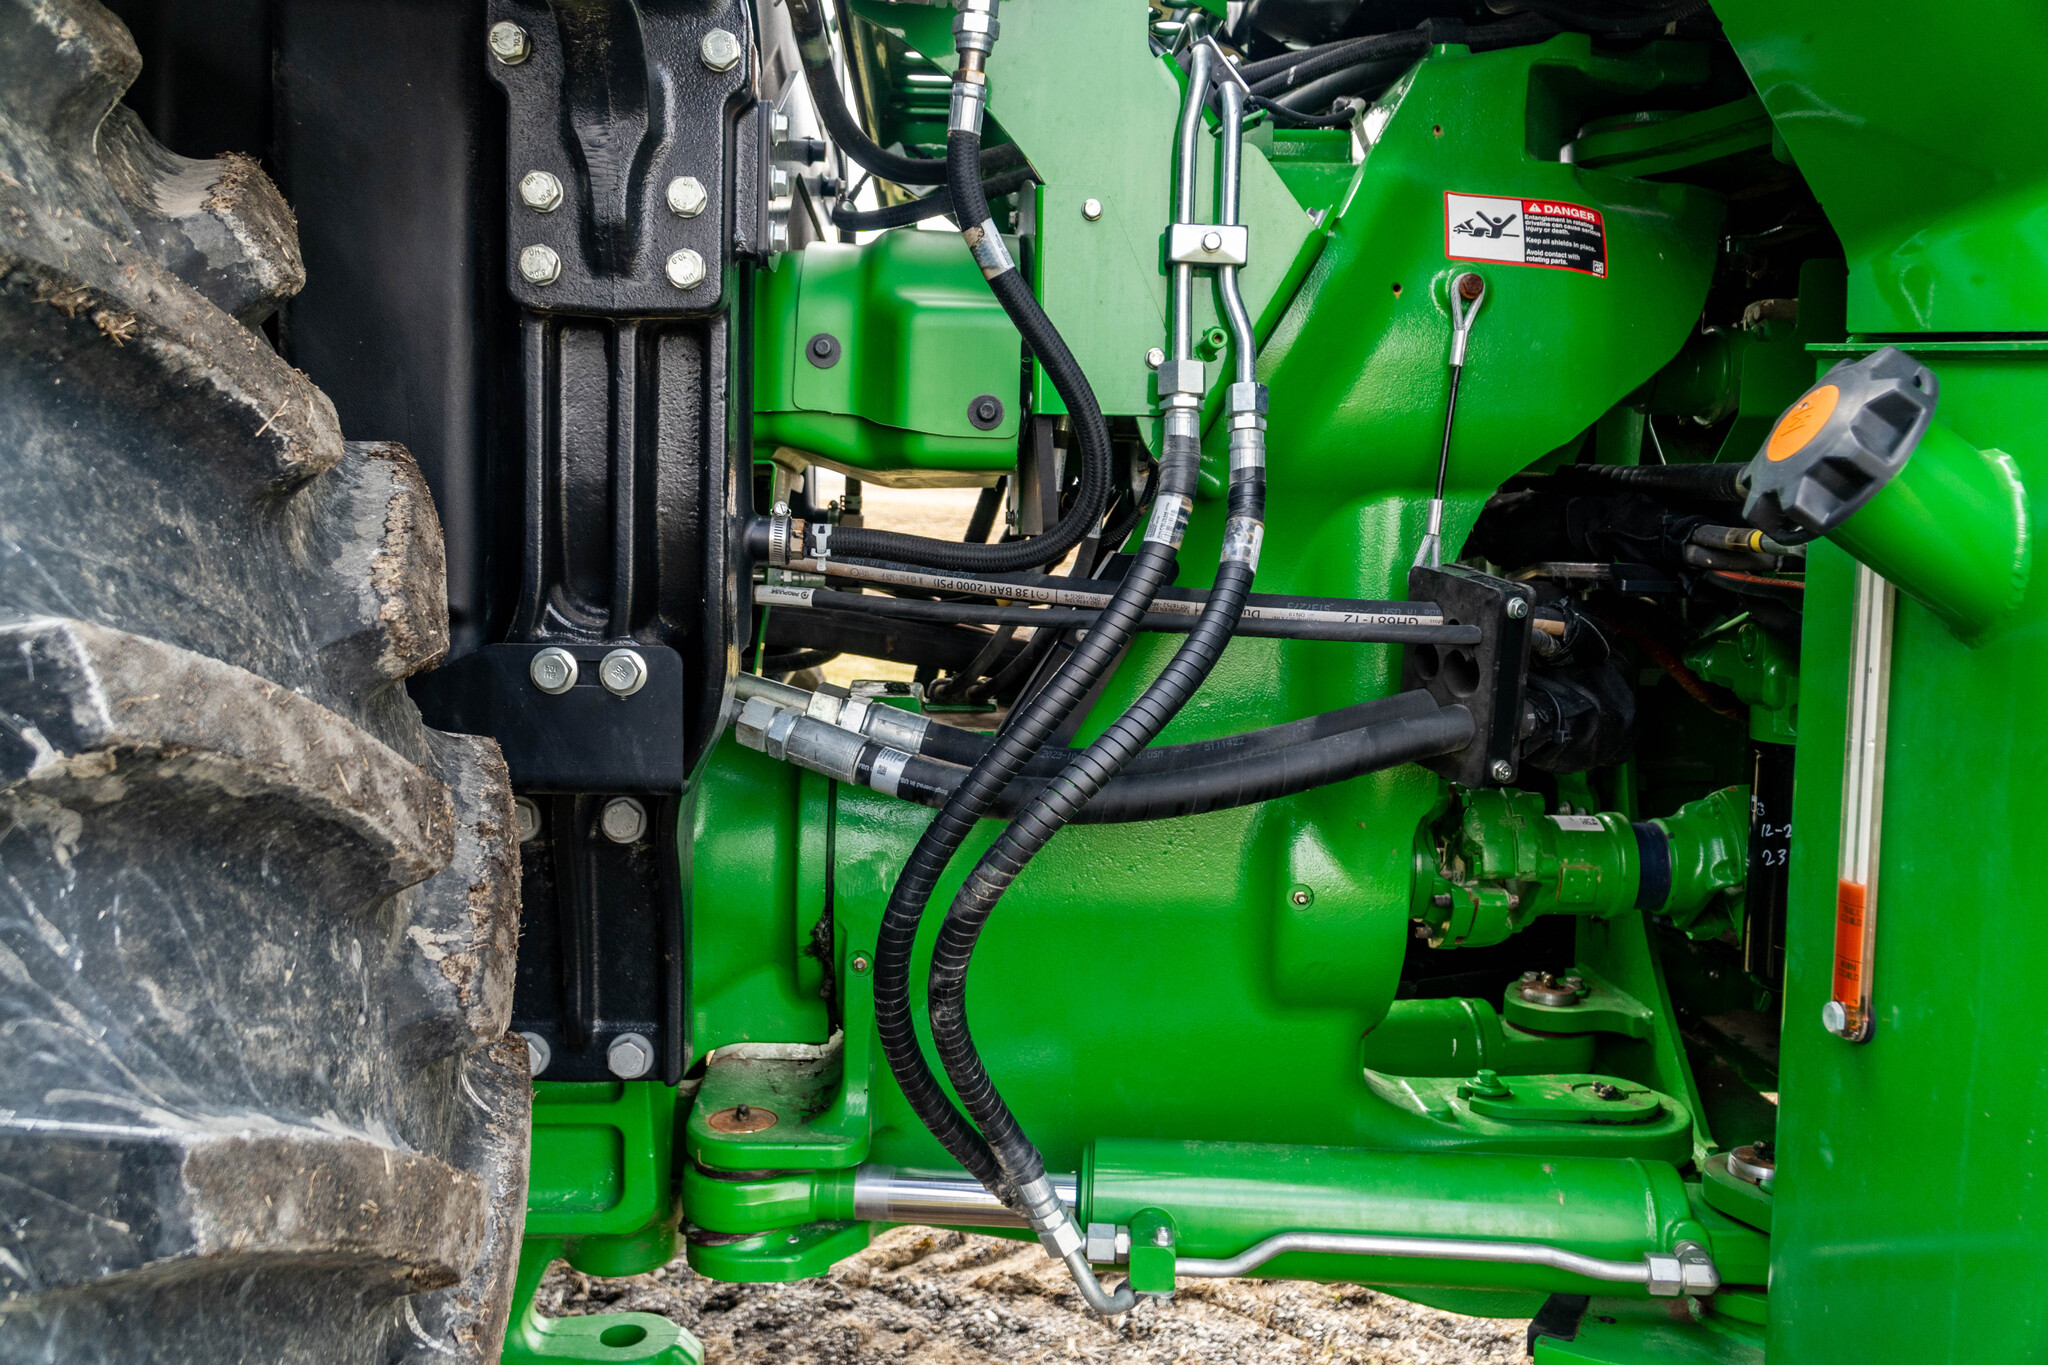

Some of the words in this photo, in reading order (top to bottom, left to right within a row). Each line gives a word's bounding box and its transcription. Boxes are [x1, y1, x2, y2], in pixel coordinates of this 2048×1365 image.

[1544, 205, 1595, 222] DANGER
[1524, 214, 1565, 223] Entanglement
[1573, 219, 1594, 230] rotating
[1524, 220, 1551, 228] driveline
[1581, 227, 1601, 237] serious
[1525, 226, 1543, 234] injury
[1526, 236, 1542, 245] Keep
[1551, 239, 1572, 247] shields
[1580, 243, 1597, 253] place.
[1526, 248, 1543, 256] Avoid
[1544, 251, 1567, 259] contact
[1526, 256, 1550, 264] rotating
[1550, 258, 1568, 266] parts.
[885, 561, 908, 571] Made
[933, 578, 953, 589] PSI)
[956, 581, 987, 593] (2000
[990, 585, 1012, 596] BAR
[1015, 587, 1034, 598] 138
[1424, 608, 1443, 616] ade
[1344, 614, 1419, 625] GH681-12
